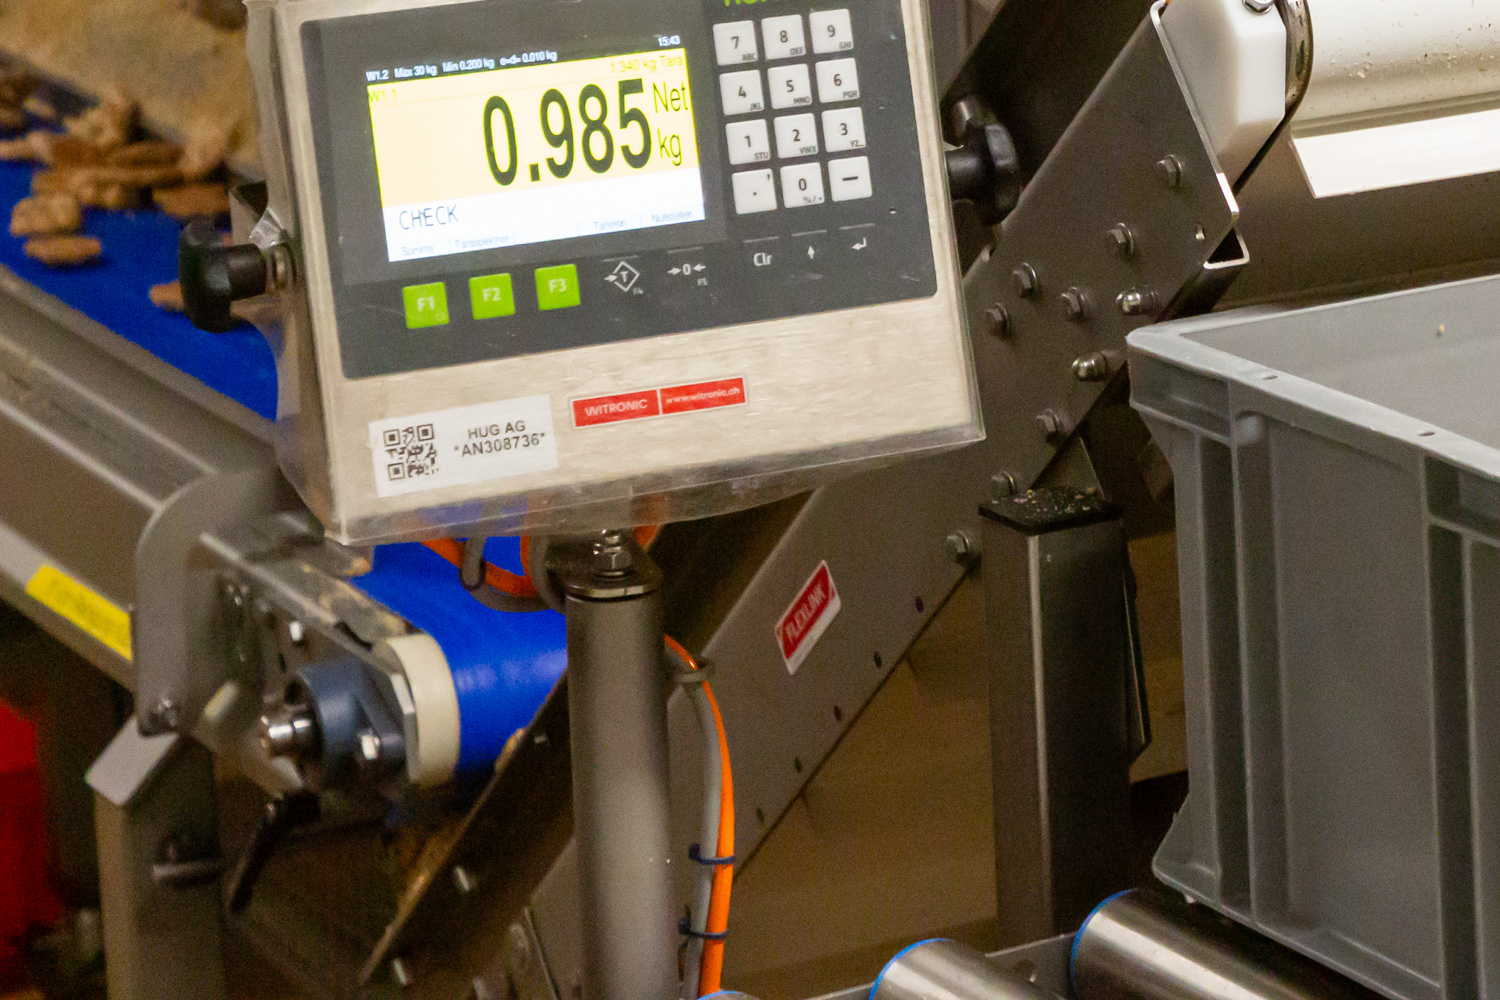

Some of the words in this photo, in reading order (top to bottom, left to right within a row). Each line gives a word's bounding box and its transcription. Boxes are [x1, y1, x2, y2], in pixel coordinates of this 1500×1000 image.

[779, 30, 789, 43] 8
[826, 24, 836, 38] 9
[658, 35, 681, 47] 15:43
[731, 35, 739, 49] 7
[839, 41, 852, 49] GHI
[742, 53, 757, 61] ABC
[790, 46, 804, 56] DEF
[366, 69, 389, 81] W1.2
[394, 67, 413, 78] Max
[413, 65, 425, 76] 30
[426, 64, 438, 76] kg
[442, 62, 459, 73] Min
[459, 58, 482, 71] 0.200
[484, 58, 495, 69] kg
[522, 51, 545, 63] 0.010
[545, 51, 557, 62] kg
[610, 59, 639, 73] 1.340
[642, 58, 656, 72] kg
[660, 55, 683, 68] Tara
[786, 79, 794, 92] 5
[833, 73, 842, 86] 6
[368, 89, 396, 102] W1.1
[738, 85, 747, 98] 4
[842, 90, 858, 99] PQR
[750, 102, 763, 111] JKL
[794, 96, 811, 105] MNO
[483, 78, 653, 187] 0.985
[652, 81, 688, 114] Net
[792, 128, 801, 142] 2
[839, 122, 848, 136] 3
[657, 128, 683, 166] kg
[744, 135, 752, 148] 1
[754, 152, 769, 161] STU
[799, 146, 817, 154] VWX
[798, 178, 807, 191] 0
[399, 204, 459, 230] CHECK
[753, 252, 773, 267] Clr
[549, 278, 567, 293] F3
[483, 287, 501, 302] F2
[417, 296, 435, 311] F1
[665, 386, 741, 404] www.witronic.ch
[584, 399, 648, 417] WITRONIC
[468, 424, 500, 439] HUG
[505, 420, 526, 433] AG
